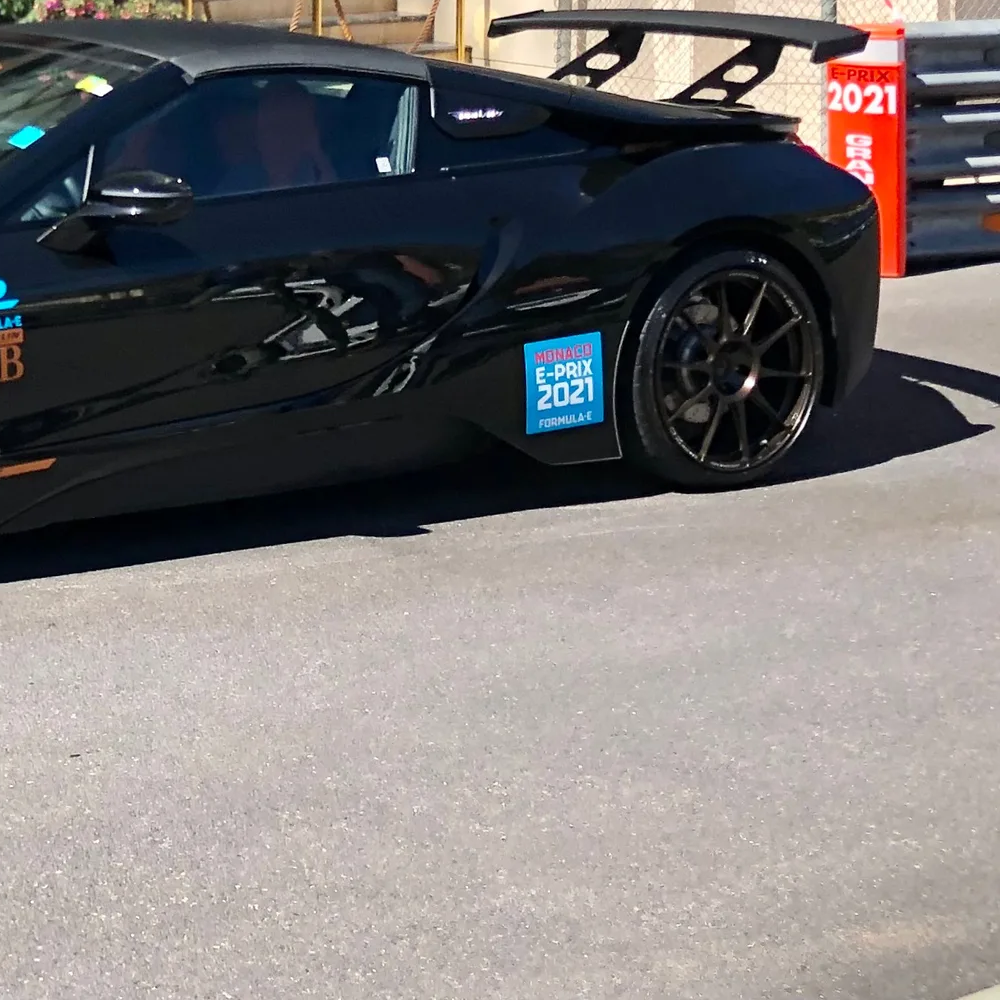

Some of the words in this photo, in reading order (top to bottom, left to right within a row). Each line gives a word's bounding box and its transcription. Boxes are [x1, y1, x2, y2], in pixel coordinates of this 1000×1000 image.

[831, 67, 891, 83] E-PRIX
[828, 80, 897, 115] 2021
[534, 343, 593, 365] MONACO
[535, 359, 594, 385] E-PRIX
[537, 376, 594, 411] 2021
